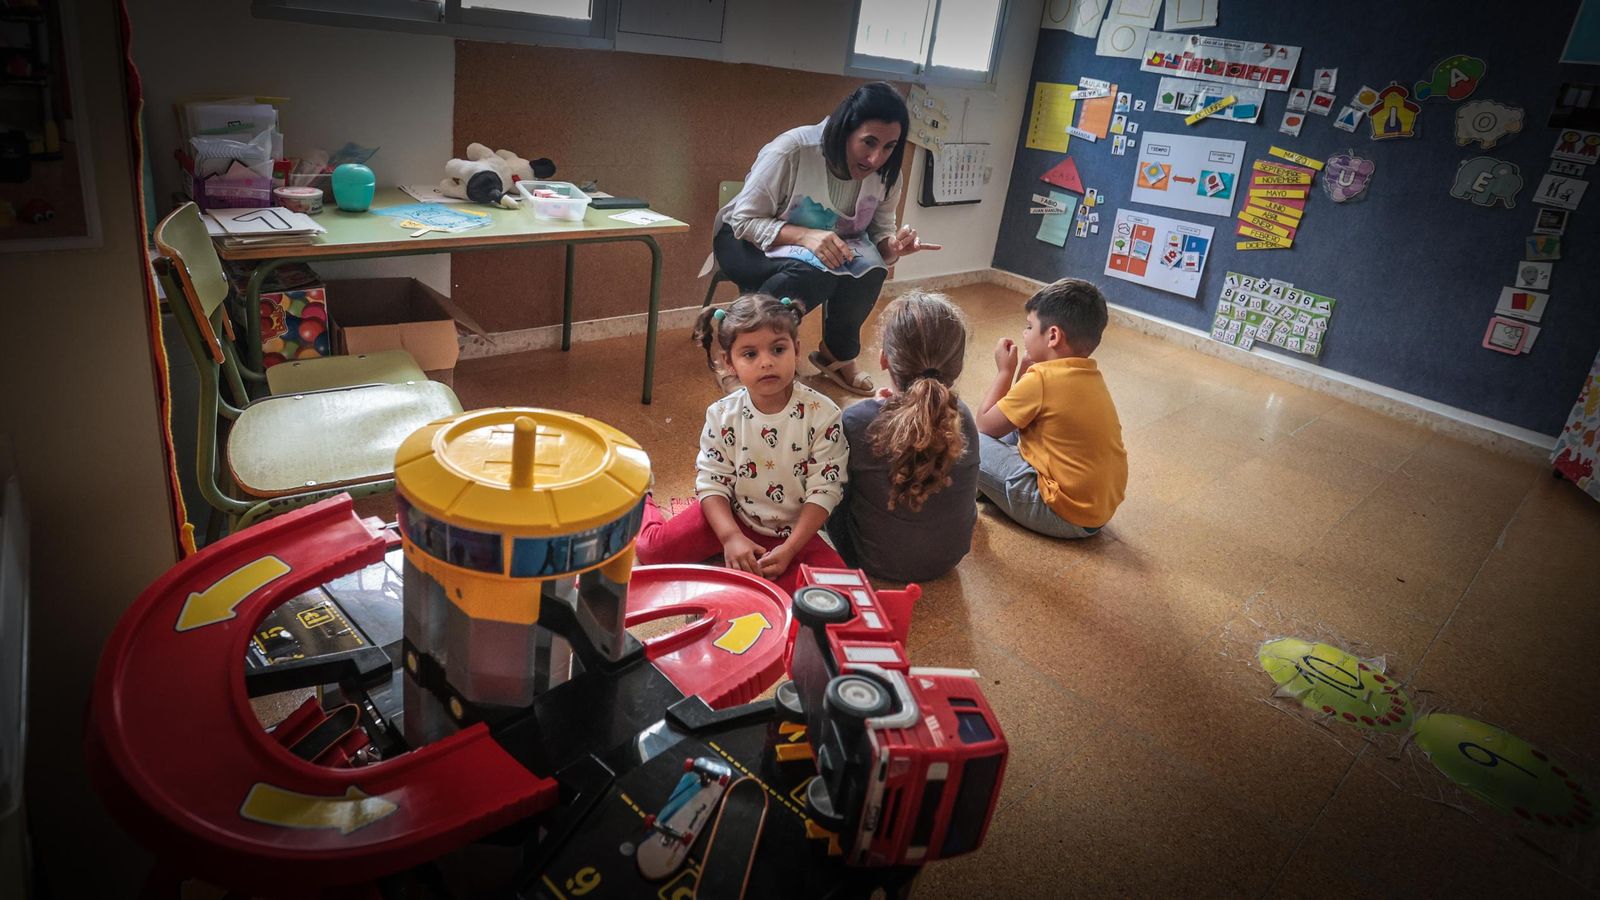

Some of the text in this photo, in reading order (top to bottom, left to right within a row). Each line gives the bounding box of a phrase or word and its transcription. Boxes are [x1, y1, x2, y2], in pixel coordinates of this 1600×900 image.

[1451, 68, 1470, 87] A
[1137, 102, 1143, 110] 2
[1130, 124, 1135, 132] 1
[1473, 112, 1497, 132] O
[1339, 169, 1355, 187] U
[1472, 172, 1494, 193] E
[1040, 197, 1058, 207] FABIO
[1252, 217, 1274, 230] ENERO
[1262, 212, 1279, 221] ABRIL
[1251, 230, 1280, 243] FEBRERO
[1229, 277, 1235, 285] 1
[1243, 279, 1251, 288] 2
[1258, 281, 1267, 289] 3
[1273, 287, 1281, 295] 4
[1288, 292, 1296, 300] 5
[1303, 297, 1311, 305] 6
[1225, 288, 1232, 297] 8
[1239, 294, 1246, 302] 9
[1268, 303, 1278, 313] 11
[1281, 310, 1291, 320] 12
[1298, 314, 1308, 324] 13
[1315, 320, 1325, 328] 14
[1216, 318, 1226, 326] 22
[1245, 328, 1254, 336] 24
[1259, 328, 1269, 338] 25
[1274, 335, 1284, 343] 26
[1289, 340, 1299, 348] 27
[1304, 344, 1315, 352] 28
[1263, 319, 1272, 329] 18
[1278, 325, 1288, 334] 19
[1309, 331, 1318, 339] 21
[1294, 655, 1364, 699] 10
[1457, 742, 1538, 780] 9
